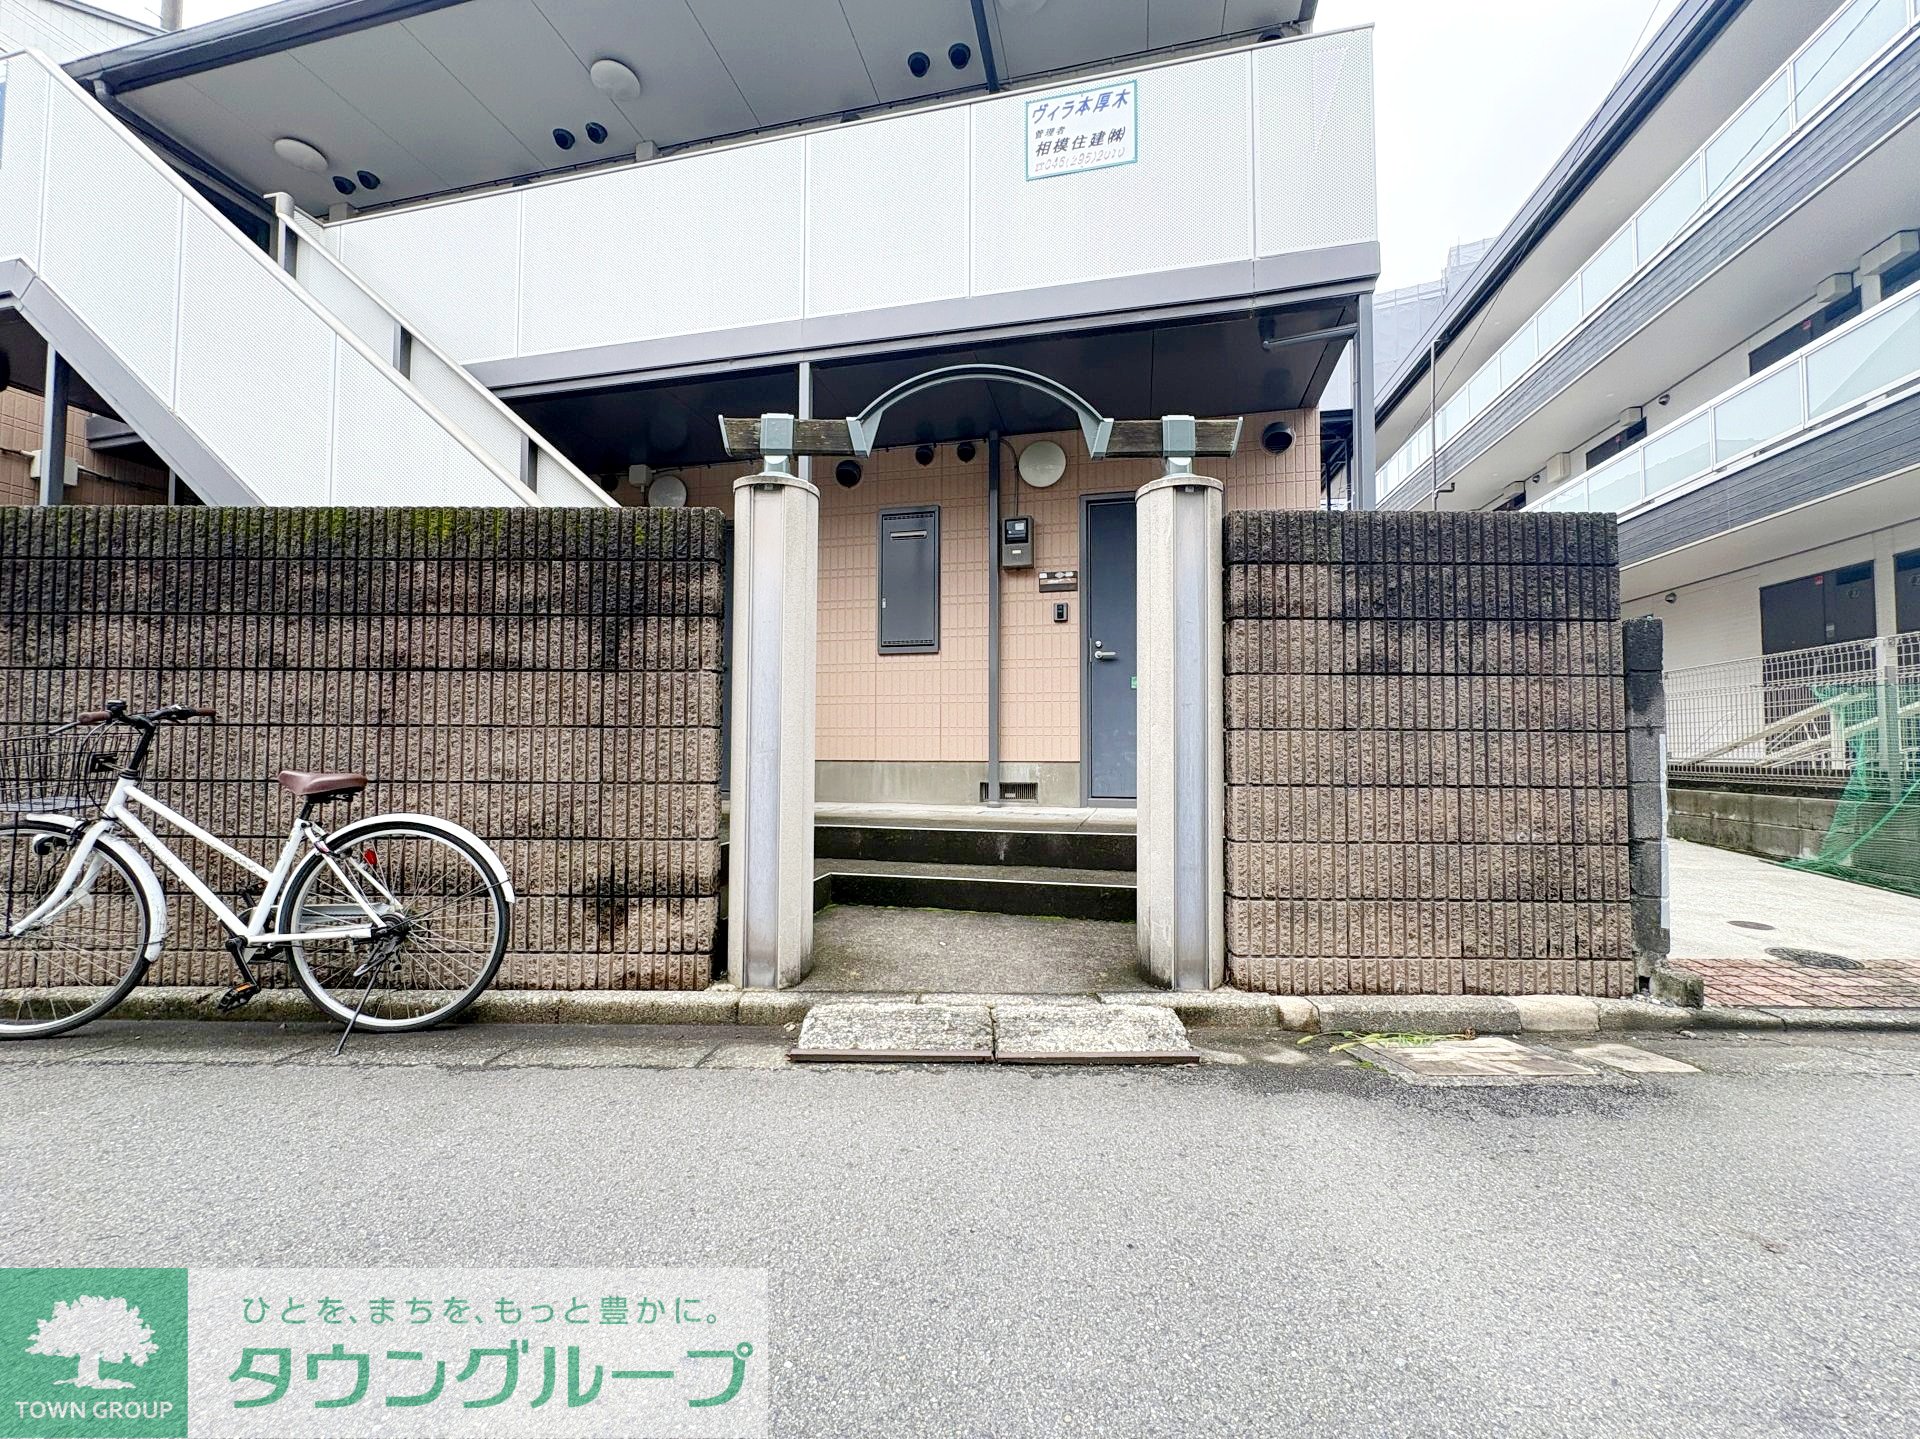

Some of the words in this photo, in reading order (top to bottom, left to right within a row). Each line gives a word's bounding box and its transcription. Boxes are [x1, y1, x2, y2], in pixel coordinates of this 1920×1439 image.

[1032, 88, 1131, 125] ヴィラ本厚木
